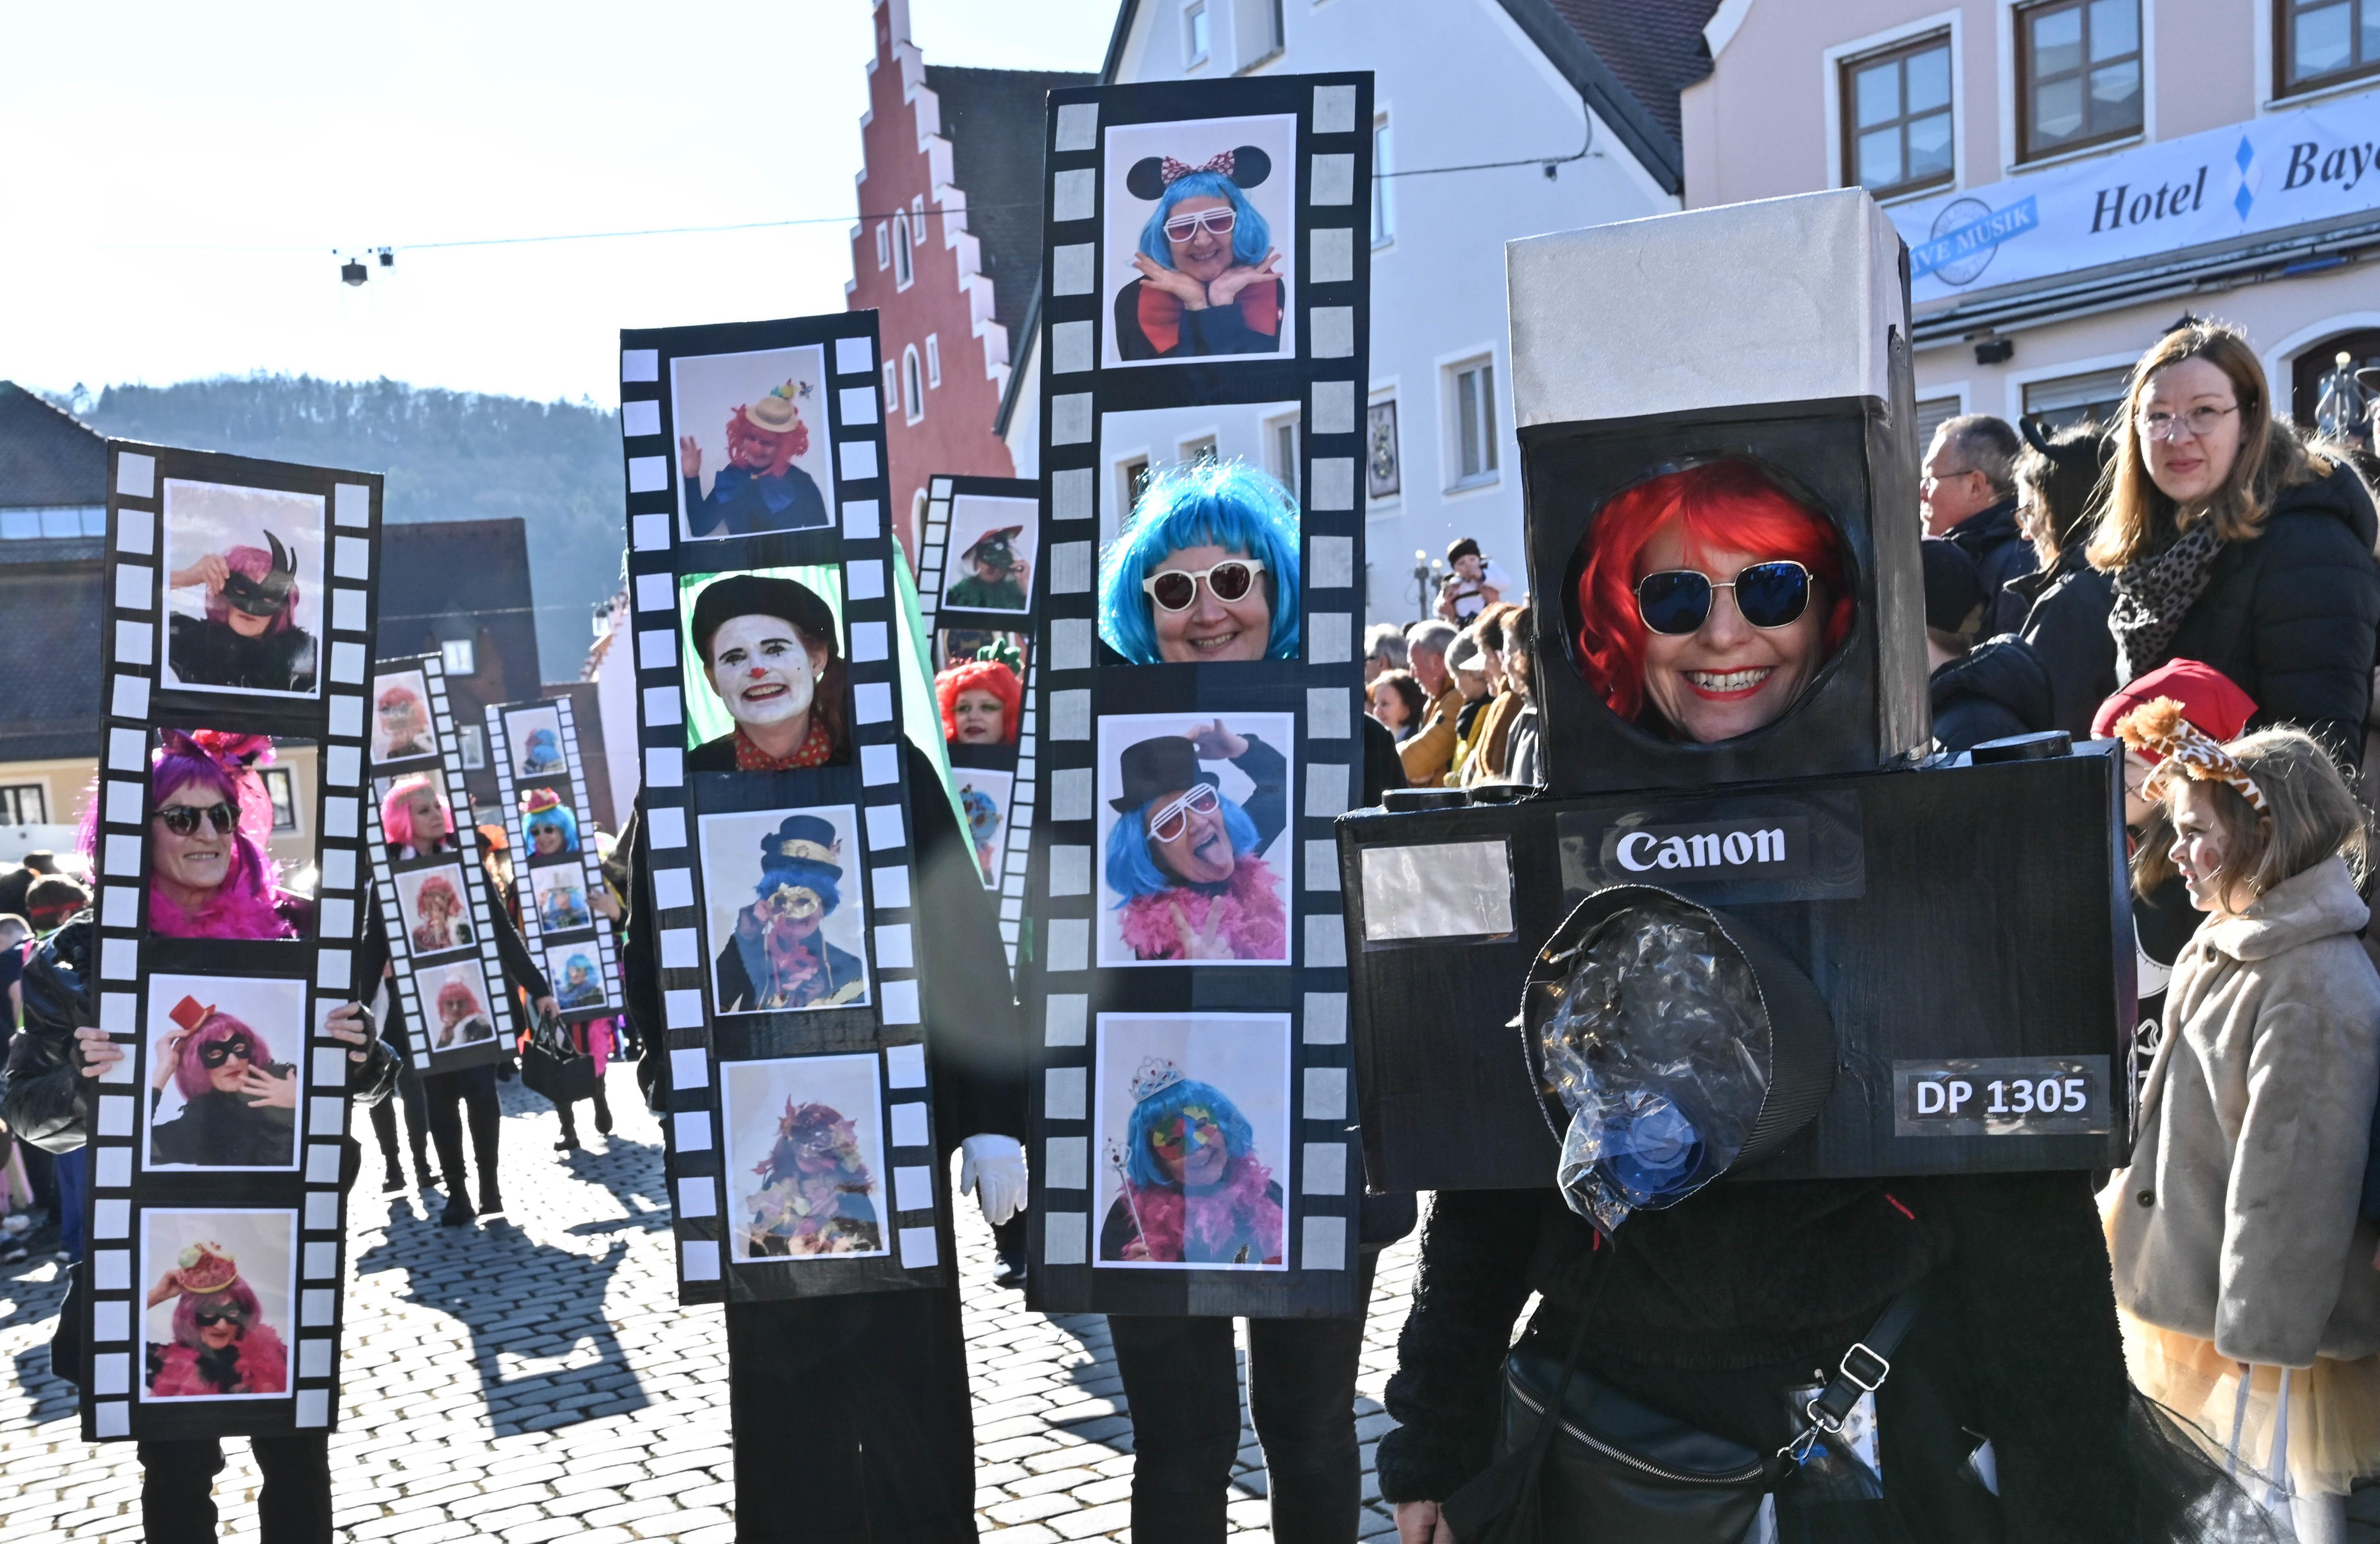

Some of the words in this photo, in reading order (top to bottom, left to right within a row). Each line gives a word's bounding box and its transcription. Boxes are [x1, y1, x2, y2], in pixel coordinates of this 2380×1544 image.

[2088, 165, 2208, 234] Hotel
[2279, 142, 2380, 192] Bay
[1911, 240, 1951, 272] IVE
[1957, 204, 2030, 255] MUSIK
[1616, 828, 1786, 872] Canon
[1917, 1080, 1973, 1114] DP
[1986, 1078, 2086, 1113] 1305
